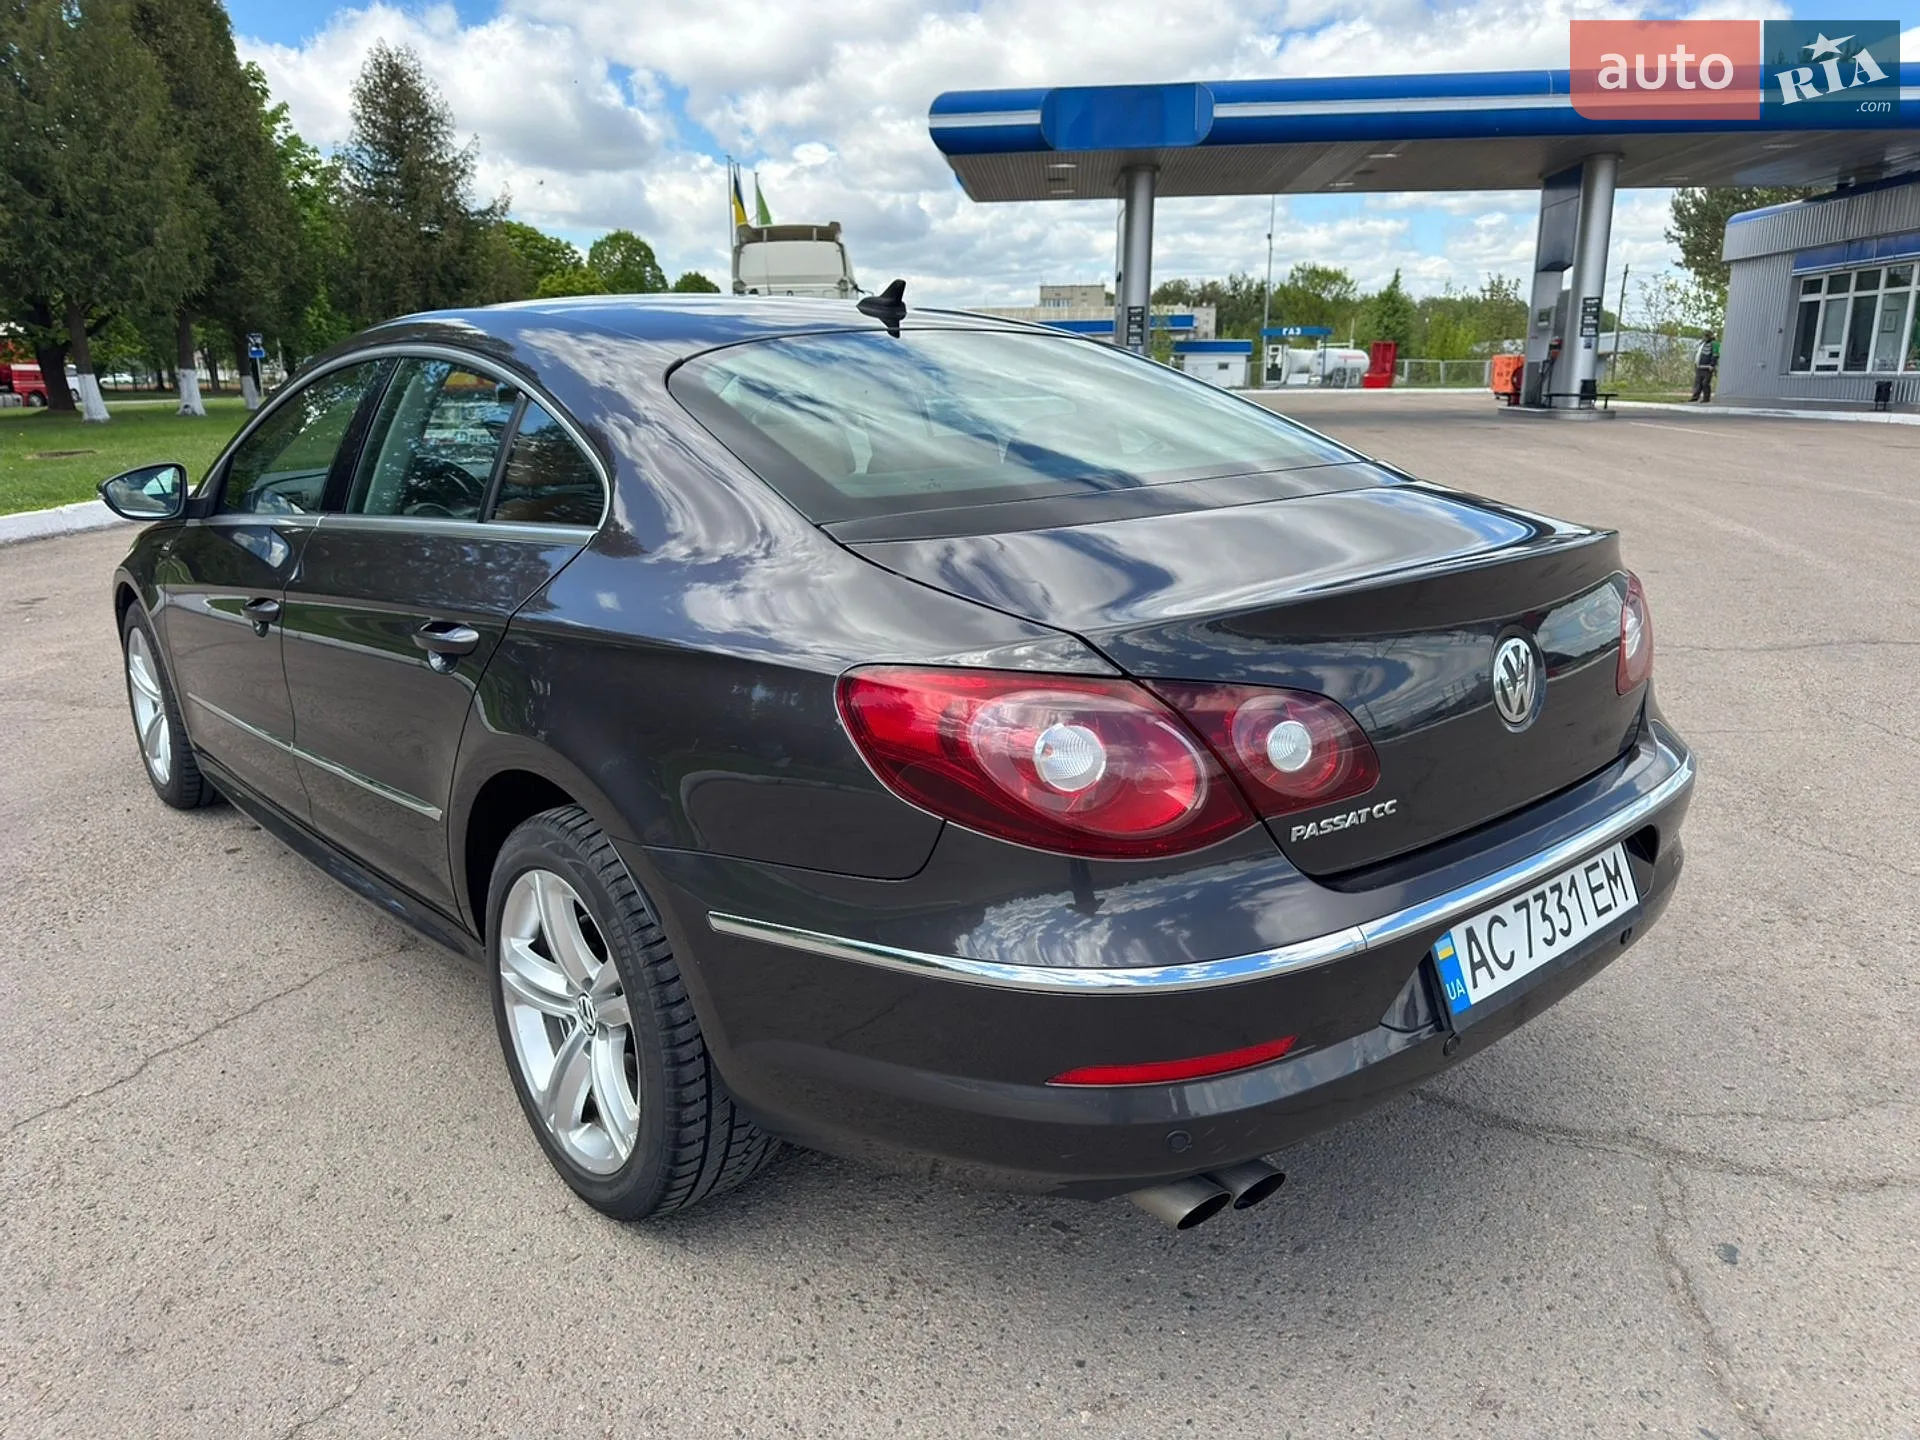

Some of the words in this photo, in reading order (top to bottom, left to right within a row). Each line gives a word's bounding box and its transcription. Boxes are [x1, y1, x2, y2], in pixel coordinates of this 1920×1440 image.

[1282, 327, 1301, 336] ГАЗ
[1290, 807, 1371, 842] PASSAT
[1372, 799, 1397, 819] CC
[1464, 914, 1515, 989] AC
[1513, 874, 1588, 958] 7331
[1583, 851, 1630, 918] EM
[1446, 978, 1467, 1001] UA
